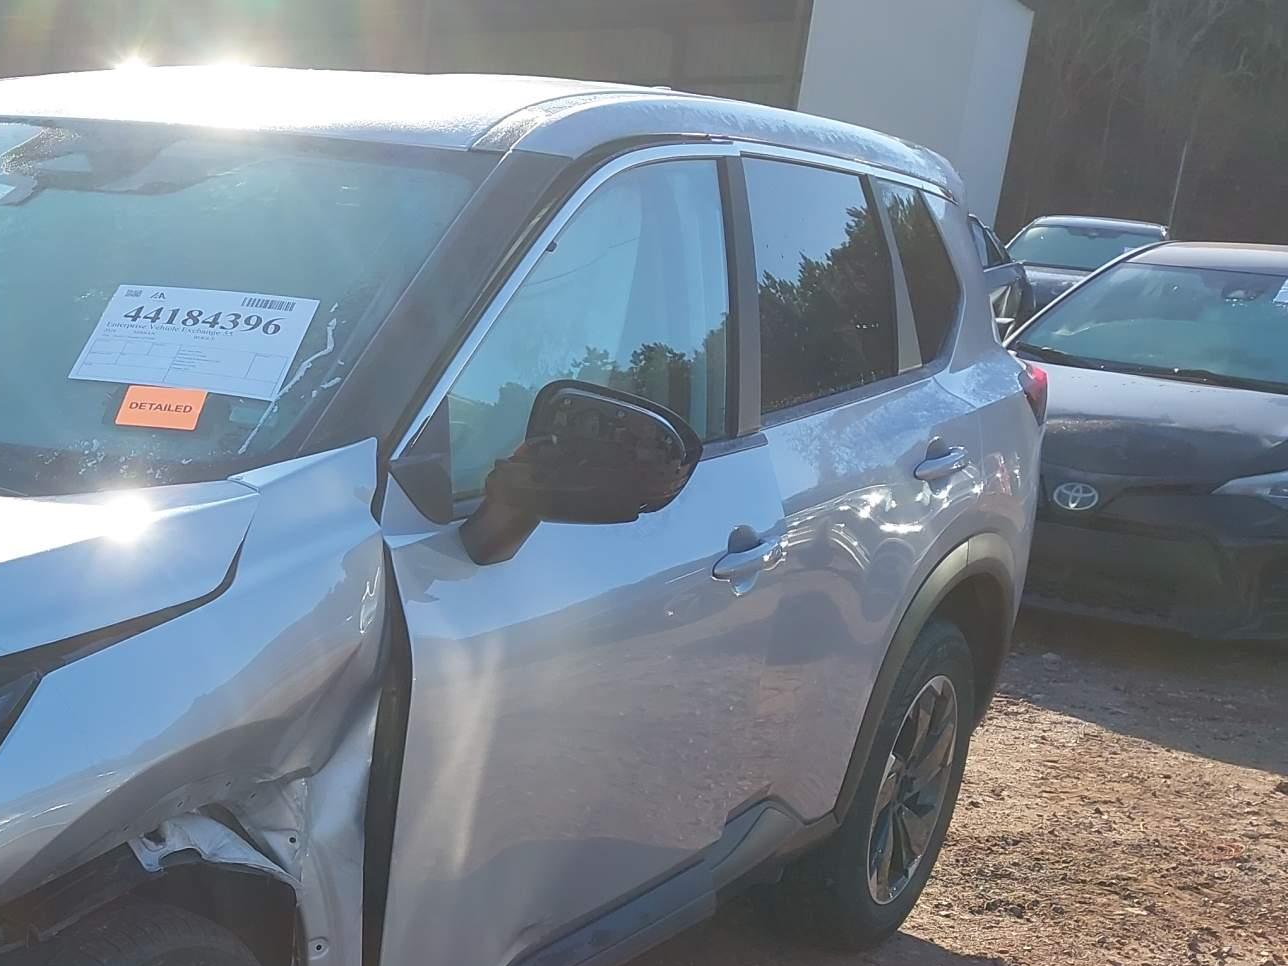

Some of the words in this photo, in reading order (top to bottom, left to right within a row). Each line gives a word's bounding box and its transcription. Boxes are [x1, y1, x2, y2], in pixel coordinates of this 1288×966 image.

[105, 321, 147, 329] Enterprise
[123, 305, 288, 336] 44184396
[128, 401, 193, 414] DETAILED
